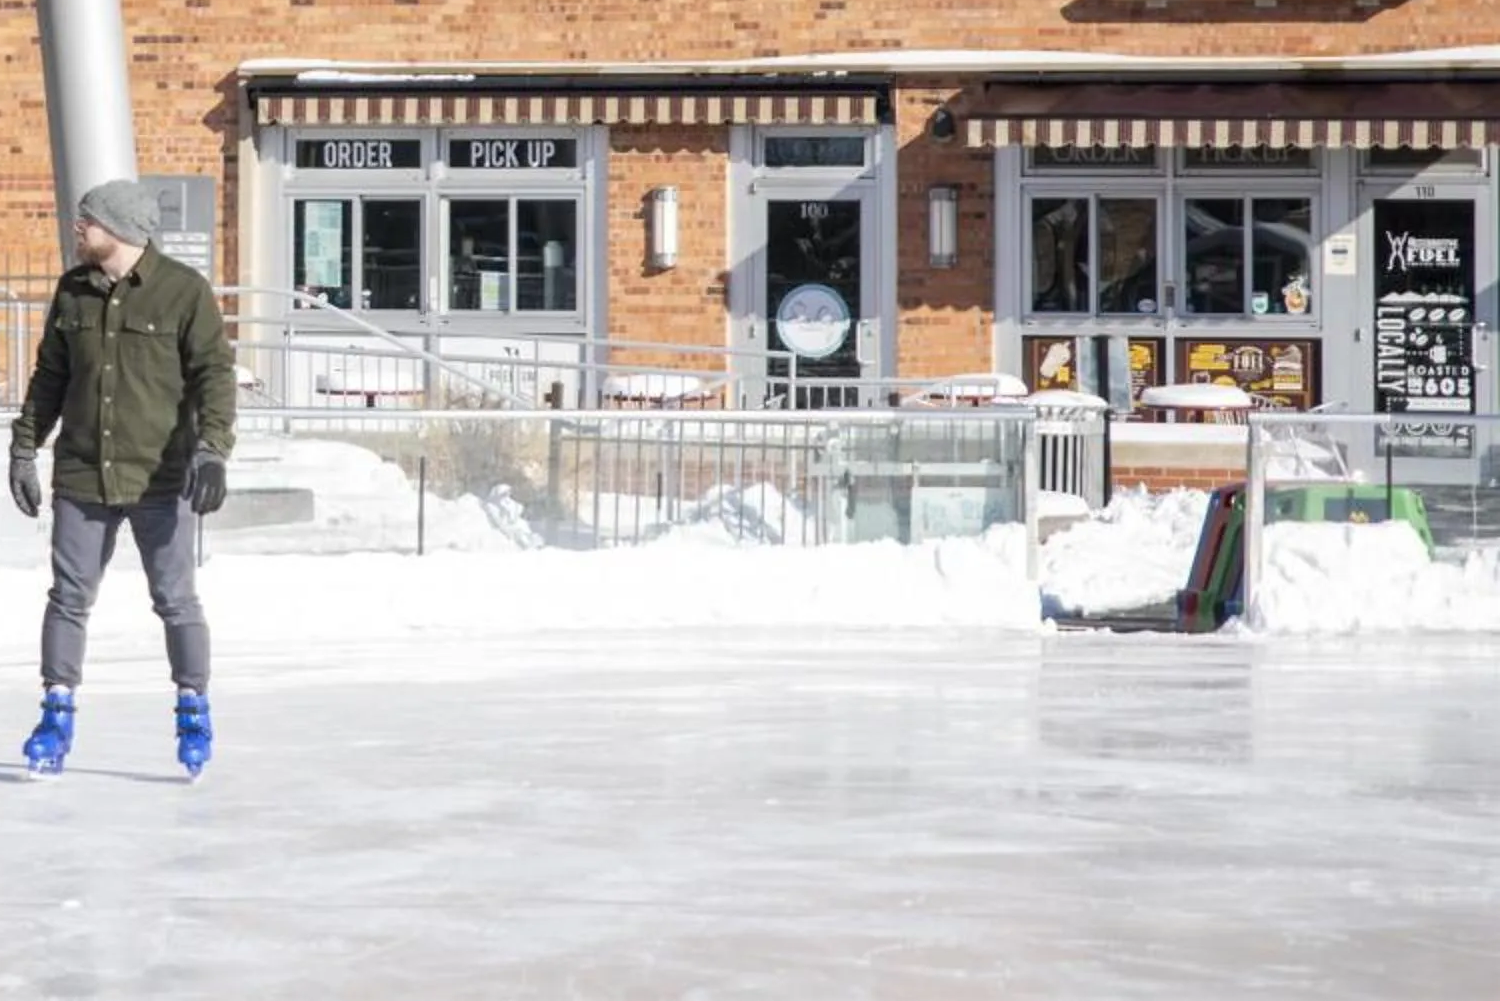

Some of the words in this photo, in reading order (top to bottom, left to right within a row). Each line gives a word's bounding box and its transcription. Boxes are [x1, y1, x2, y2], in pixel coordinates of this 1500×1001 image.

[323, 141, 393, 168] ORDER
[470, 141, 520, 168] PICK
[527, 141, 556, 168] UP
[800, 202, 829, 219] 100
[1377, 306, 1406, 394] LOCALLY
